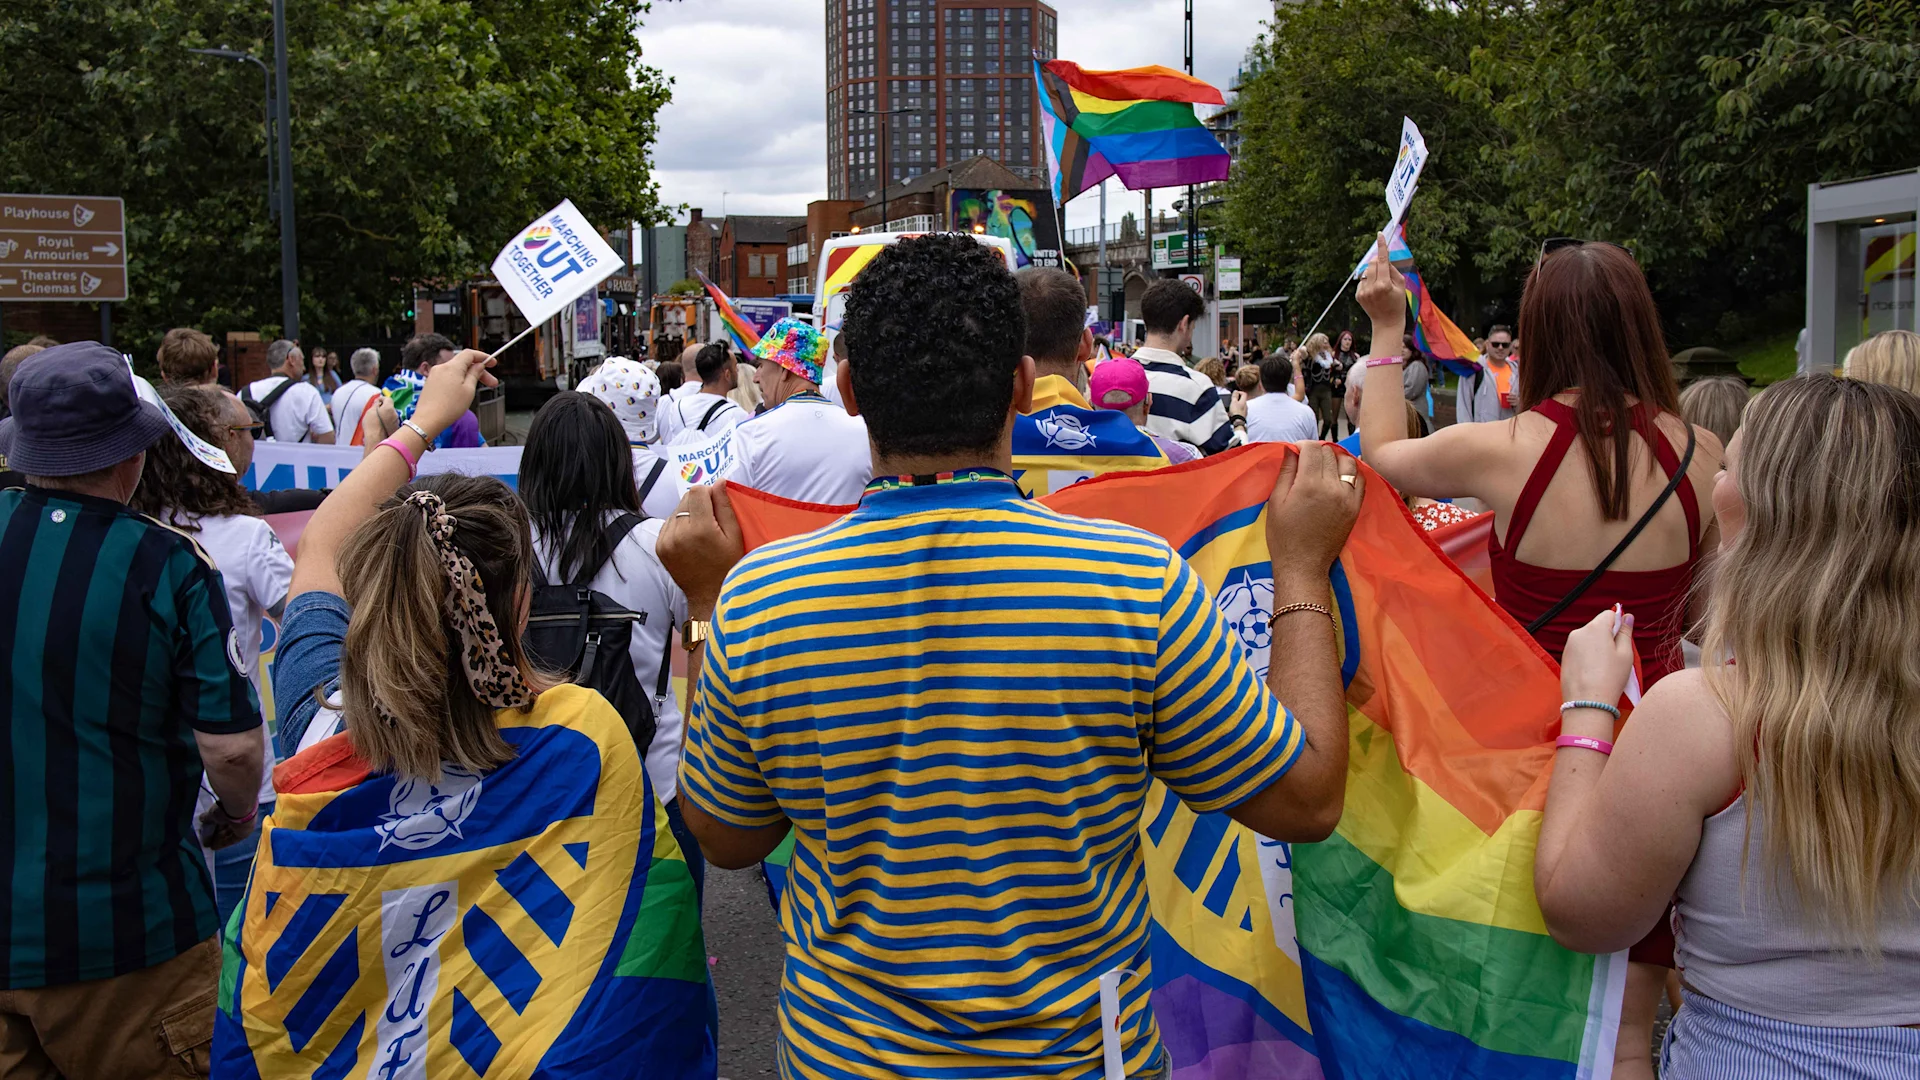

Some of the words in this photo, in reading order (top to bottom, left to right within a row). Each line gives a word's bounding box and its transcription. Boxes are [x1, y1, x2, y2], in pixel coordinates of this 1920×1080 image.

[4, 206, 70, 220] Playhouse
[38, 235, 74, 249] Royal
[549, 215, 598, 268] MARCHING
[24, 248, 90, 260] Armouries
[1033, 249, 1057, 258] UNITED
[1033, 258, 1043, 267] TO
[1044, 258, 1058, 267] END
[21, 269, 77, 281] Theatres
[509, 245, 553, 299] TOGETHER
[22, 282, 77, 294] Cinemas
[678, 429, 732, 463] MARCHING
